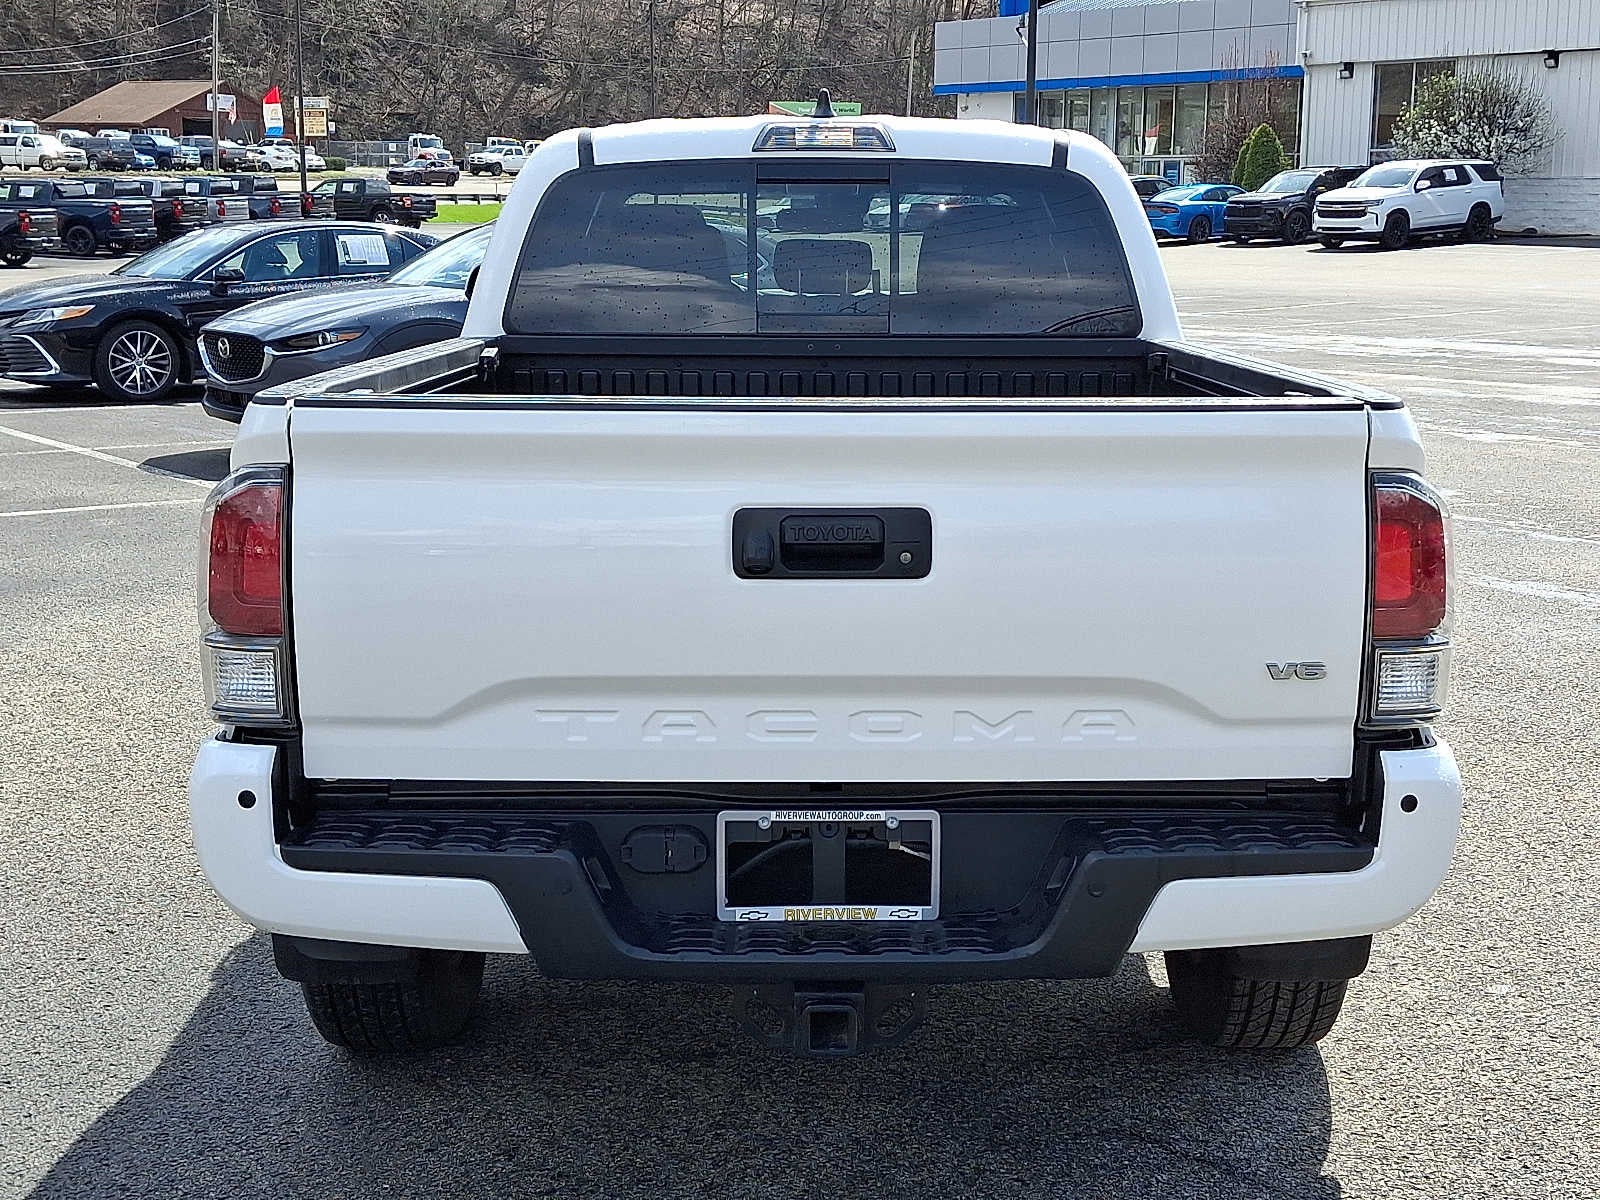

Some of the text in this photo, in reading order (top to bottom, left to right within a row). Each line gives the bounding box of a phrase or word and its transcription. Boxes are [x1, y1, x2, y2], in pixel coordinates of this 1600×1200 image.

[790, 525, 874, 541] TOYOTA
[1265, 661, 1327, 680] V6
[535, 709, 1137, 743] TACOMA
[775, 811, 882, 820] RIVERVIEWAUTOGROUP.com
[784, 907, 878, 920] RIVERVIEW
